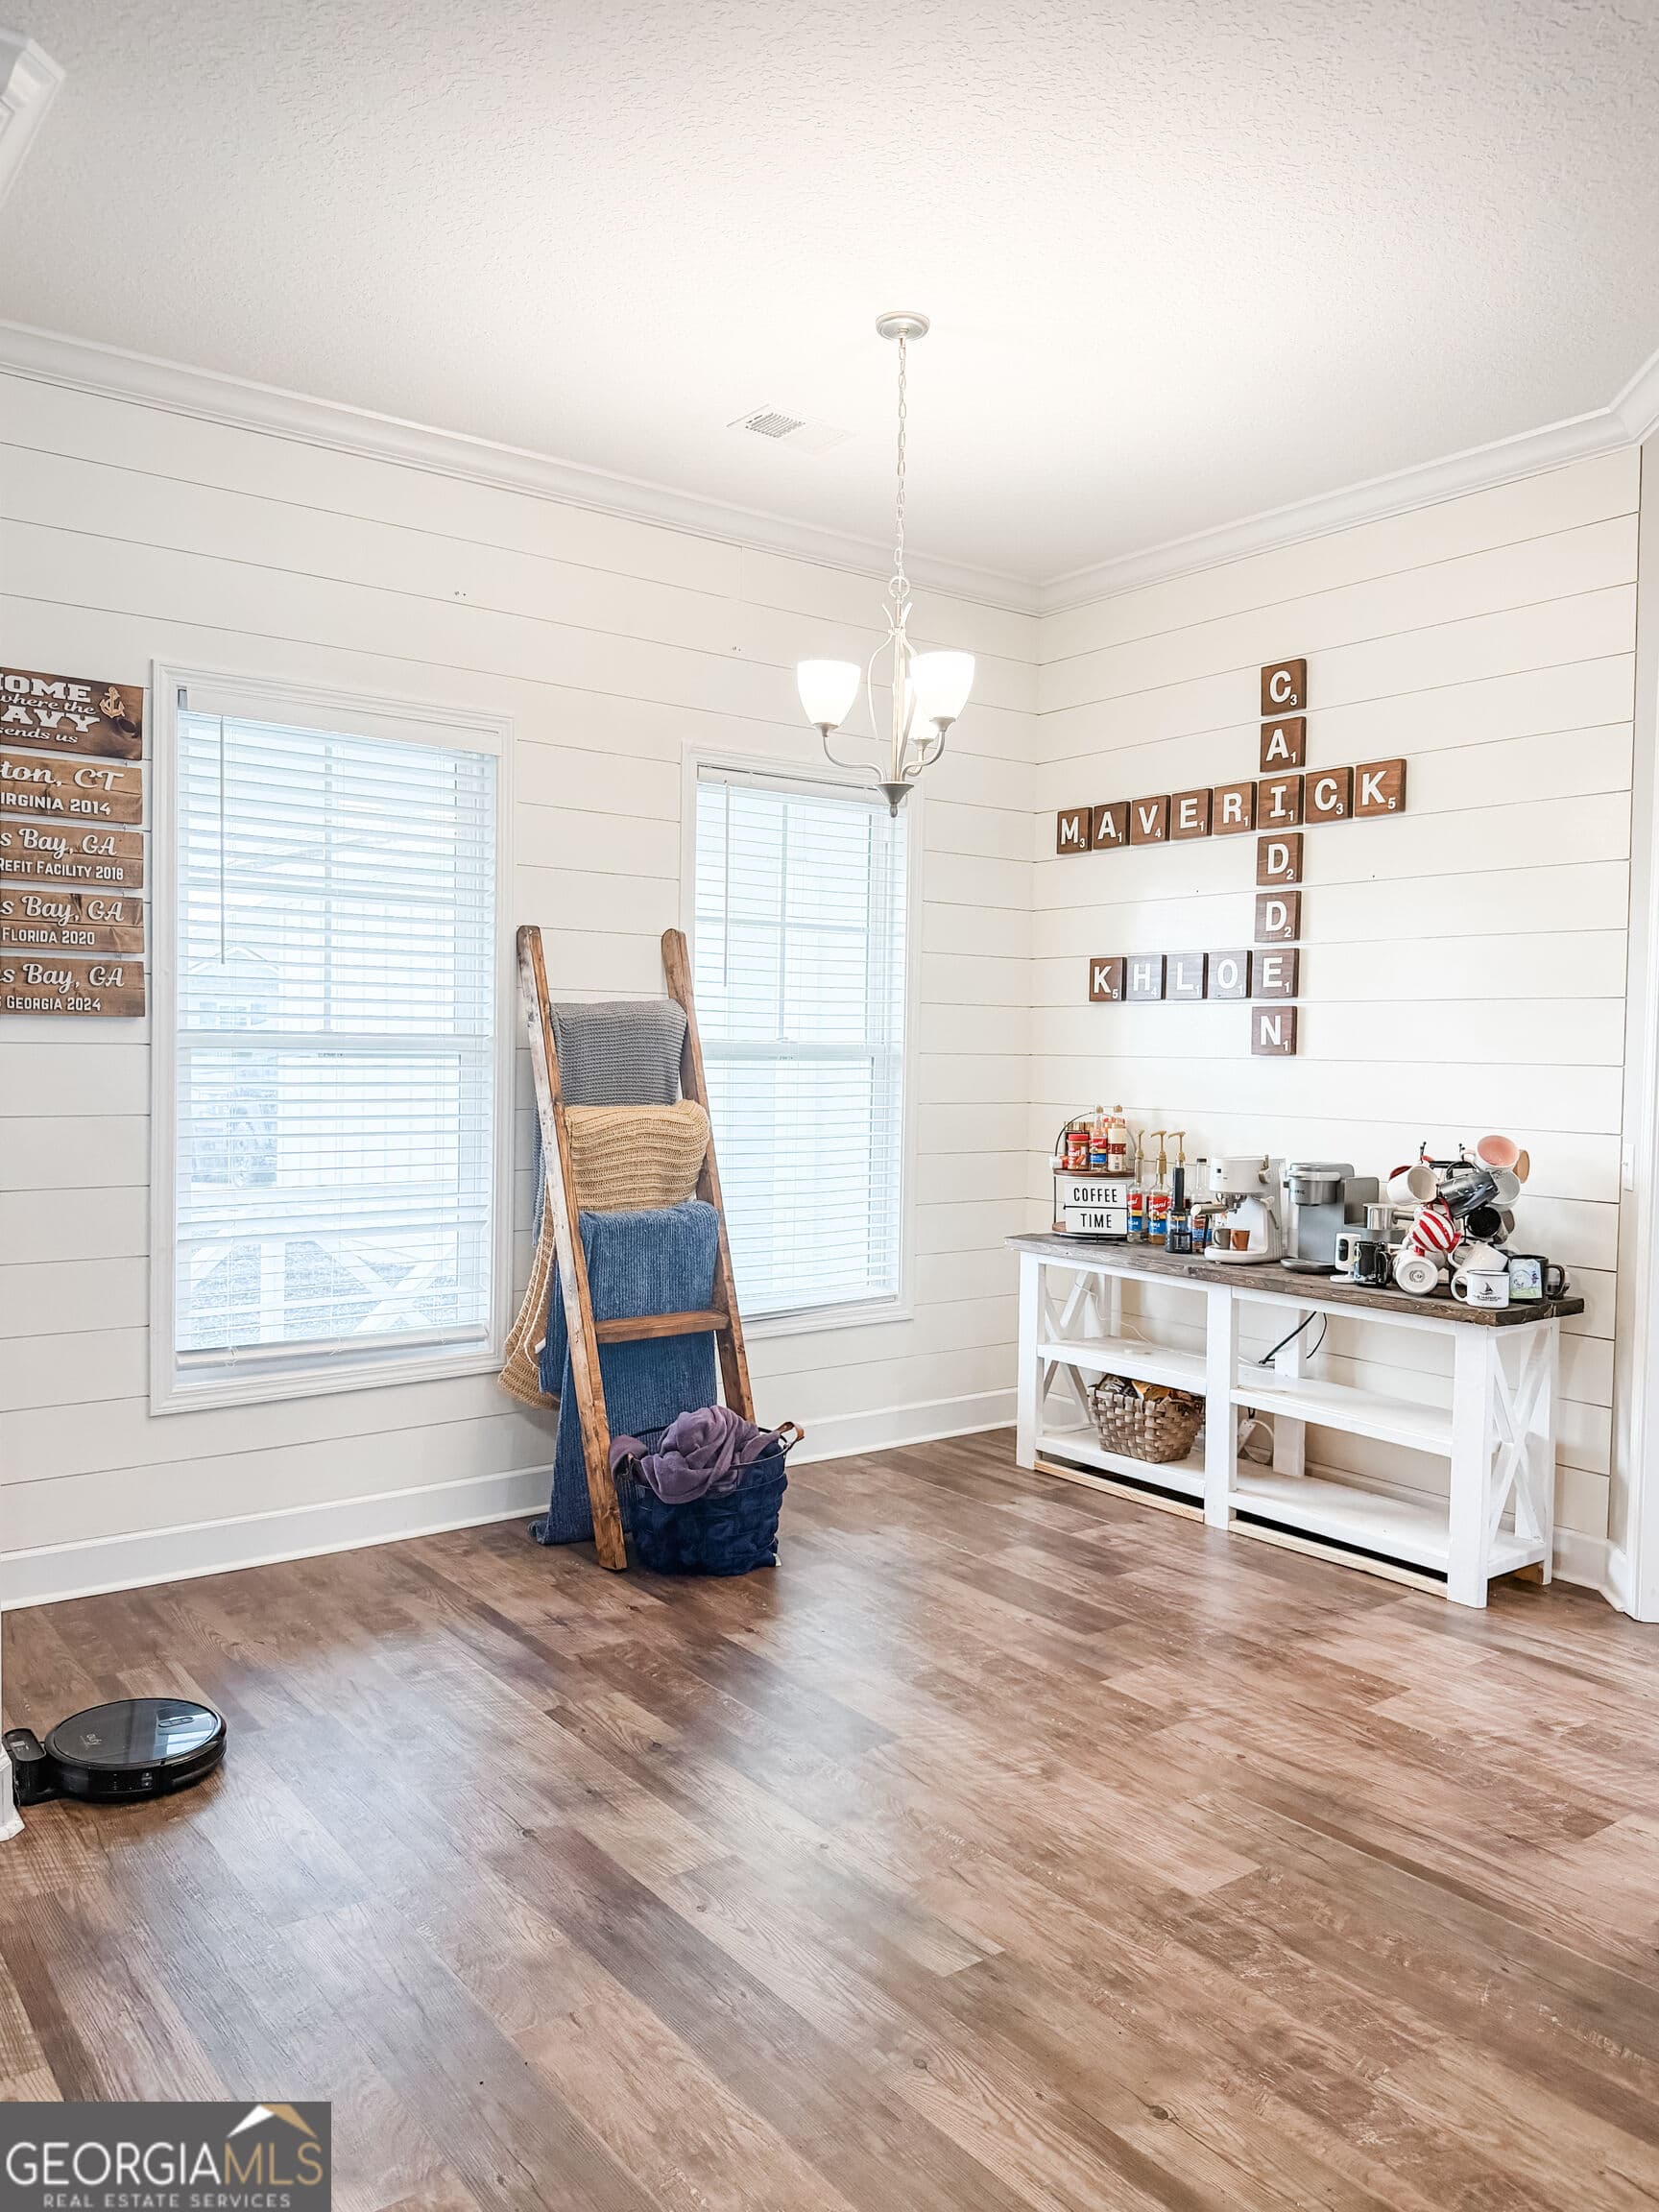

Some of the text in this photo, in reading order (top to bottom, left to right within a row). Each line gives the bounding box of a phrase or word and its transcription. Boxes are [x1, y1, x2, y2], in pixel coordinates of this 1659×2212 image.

[0, 673, 92, 703] OME
[64, 701, 96, 714] the
[56, 733, 78, 743] us
[74, 768, 124, 791] CT
[69, 799, 111, 815] 2014
[18, 829, 74, 859] Bay,
[82, 834, 117, 855] GA
[96, 866, 125, 880] 2018
[21, 895, 80, 926] Bay,
[88, 900, 124, 922] GA
[2, 927, 95, 945] FLORIDA 2020
[22, 963, 81, 994] Bay,
[88, 966, 125, 988] GA
[7, 995, 62, 1010] GEORGIA
[66, 997, 101, 1012] 2024
[1073, 1188, 1118, 1203] COFFEE
[1080, 1213, 1112, 1229] TIME
